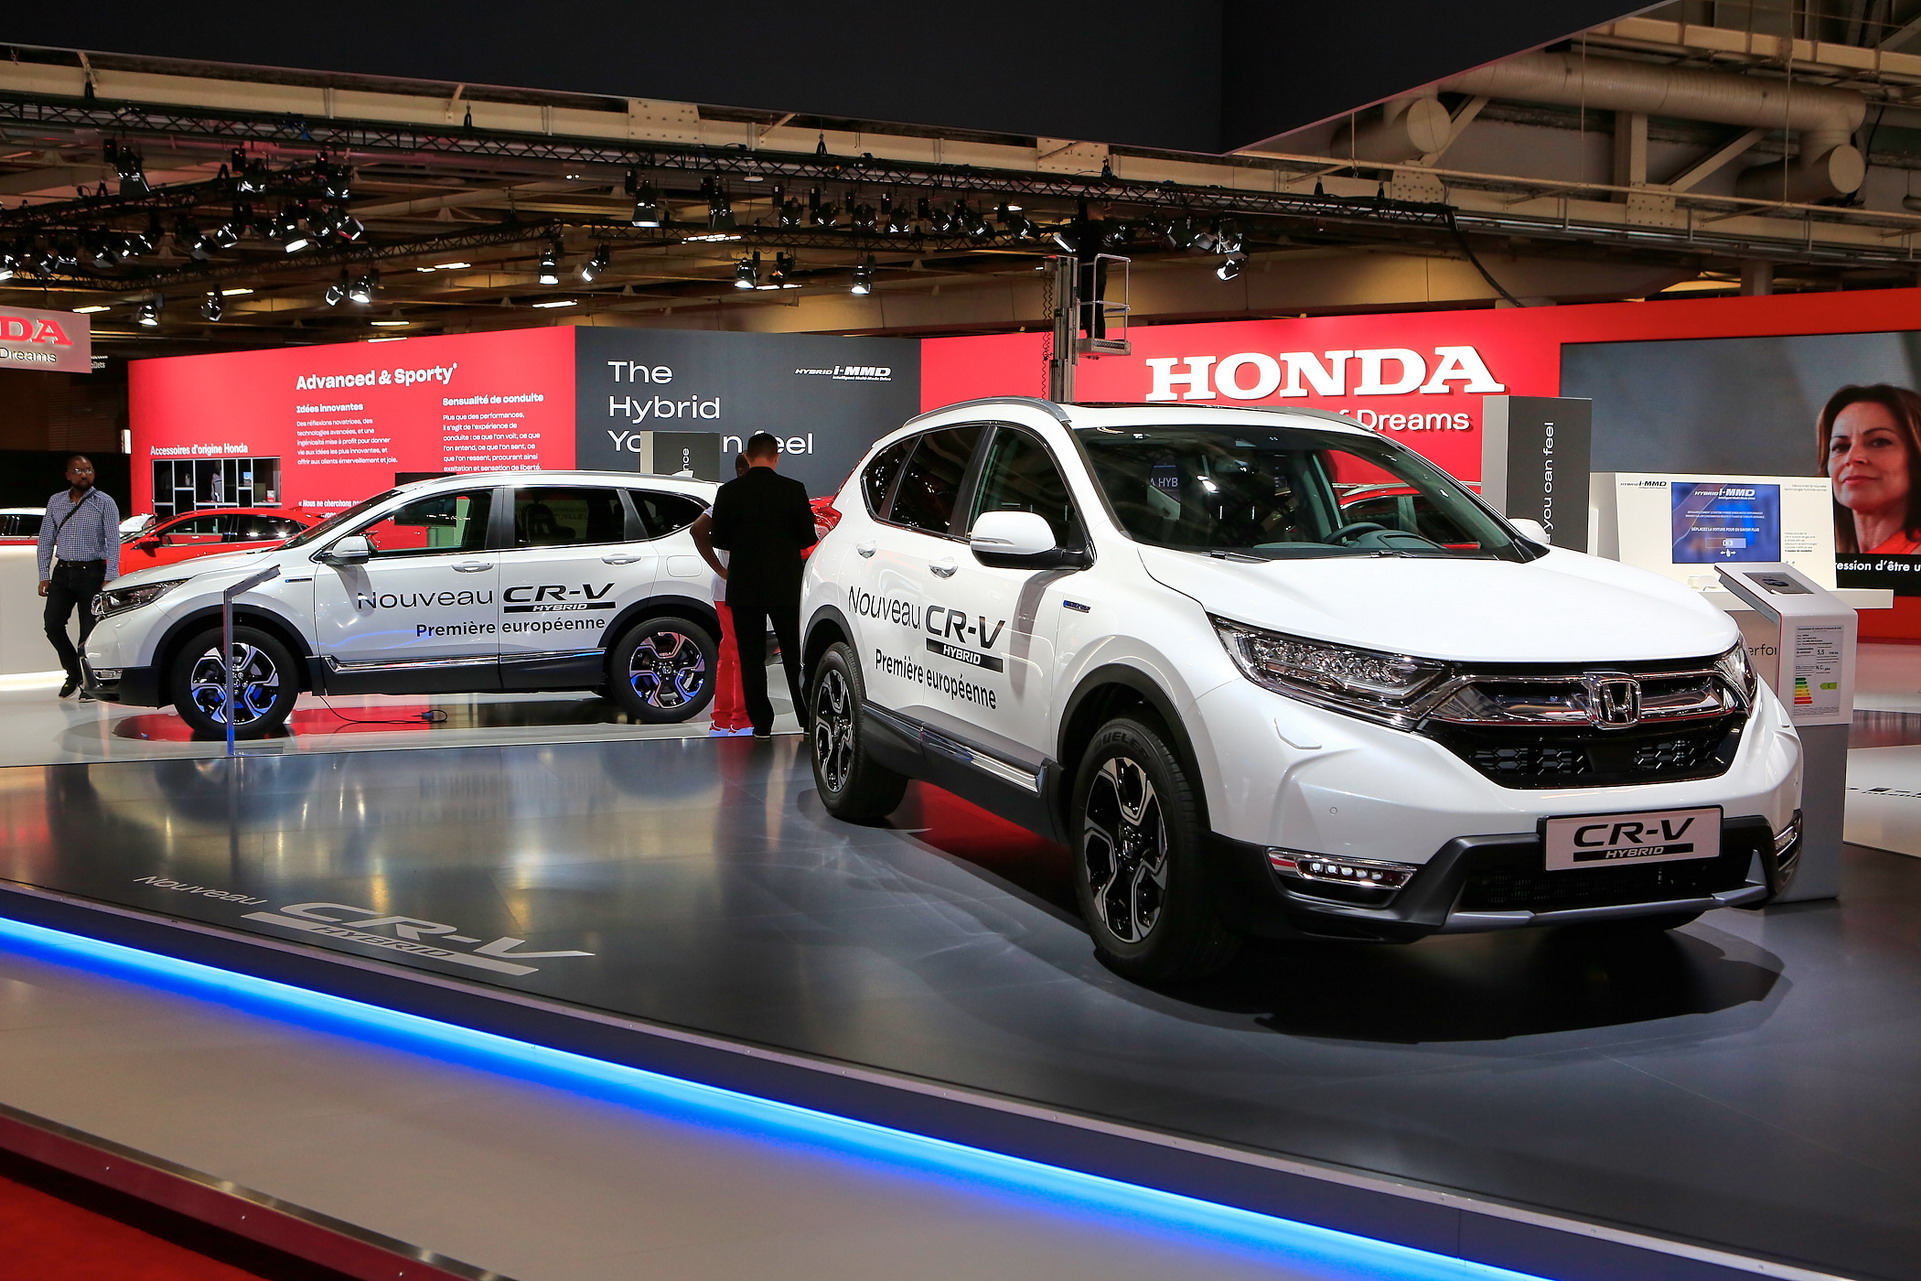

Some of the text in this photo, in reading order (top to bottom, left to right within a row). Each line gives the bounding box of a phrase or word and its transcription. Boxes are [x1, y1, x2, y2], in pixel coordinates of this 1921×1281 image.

[296, 370, 376, 390] Advanced
[378, 369, 392, 385] &
[607, 360, 673, 384] The
[833, 366, 892, 376] i-MMD
[1146, 346, 1506, 401] HONDA
[296, 402, 364, 414] Idées innovantes
[442, 392, 544, 406] Sensualité de conduite
[609, 394, 720, 424] Hybrid
[1358, 410, 1470, 432] Dreams
[150, 443, 248, 456] Accessoires d'origine Honda
[1542, 422, 1554, 456] feel
[1544, 459, 1553, 493] can
[1719, 488, 1755, 497] i-MMD
[1543, 497, 1554, 530] you
[358, 582, 615, 609] Nouveau CR-V
[532, 603, 587, 612] HYBRID
[416, 617, 605, 637] Première européenne
[848, 586, 1006, 649] Nouveau CR-V
[943, 644, 981, 665] HYBRID
[875, 648, 996, 710] Première européenne
[1573, 818, 1695, 848] CR-V
[1605, 847, 1664, 859] HYBRID
[134, 874, 596, 959] Nouveau CR-V
[309, 925, 457, 958] HYBRID
